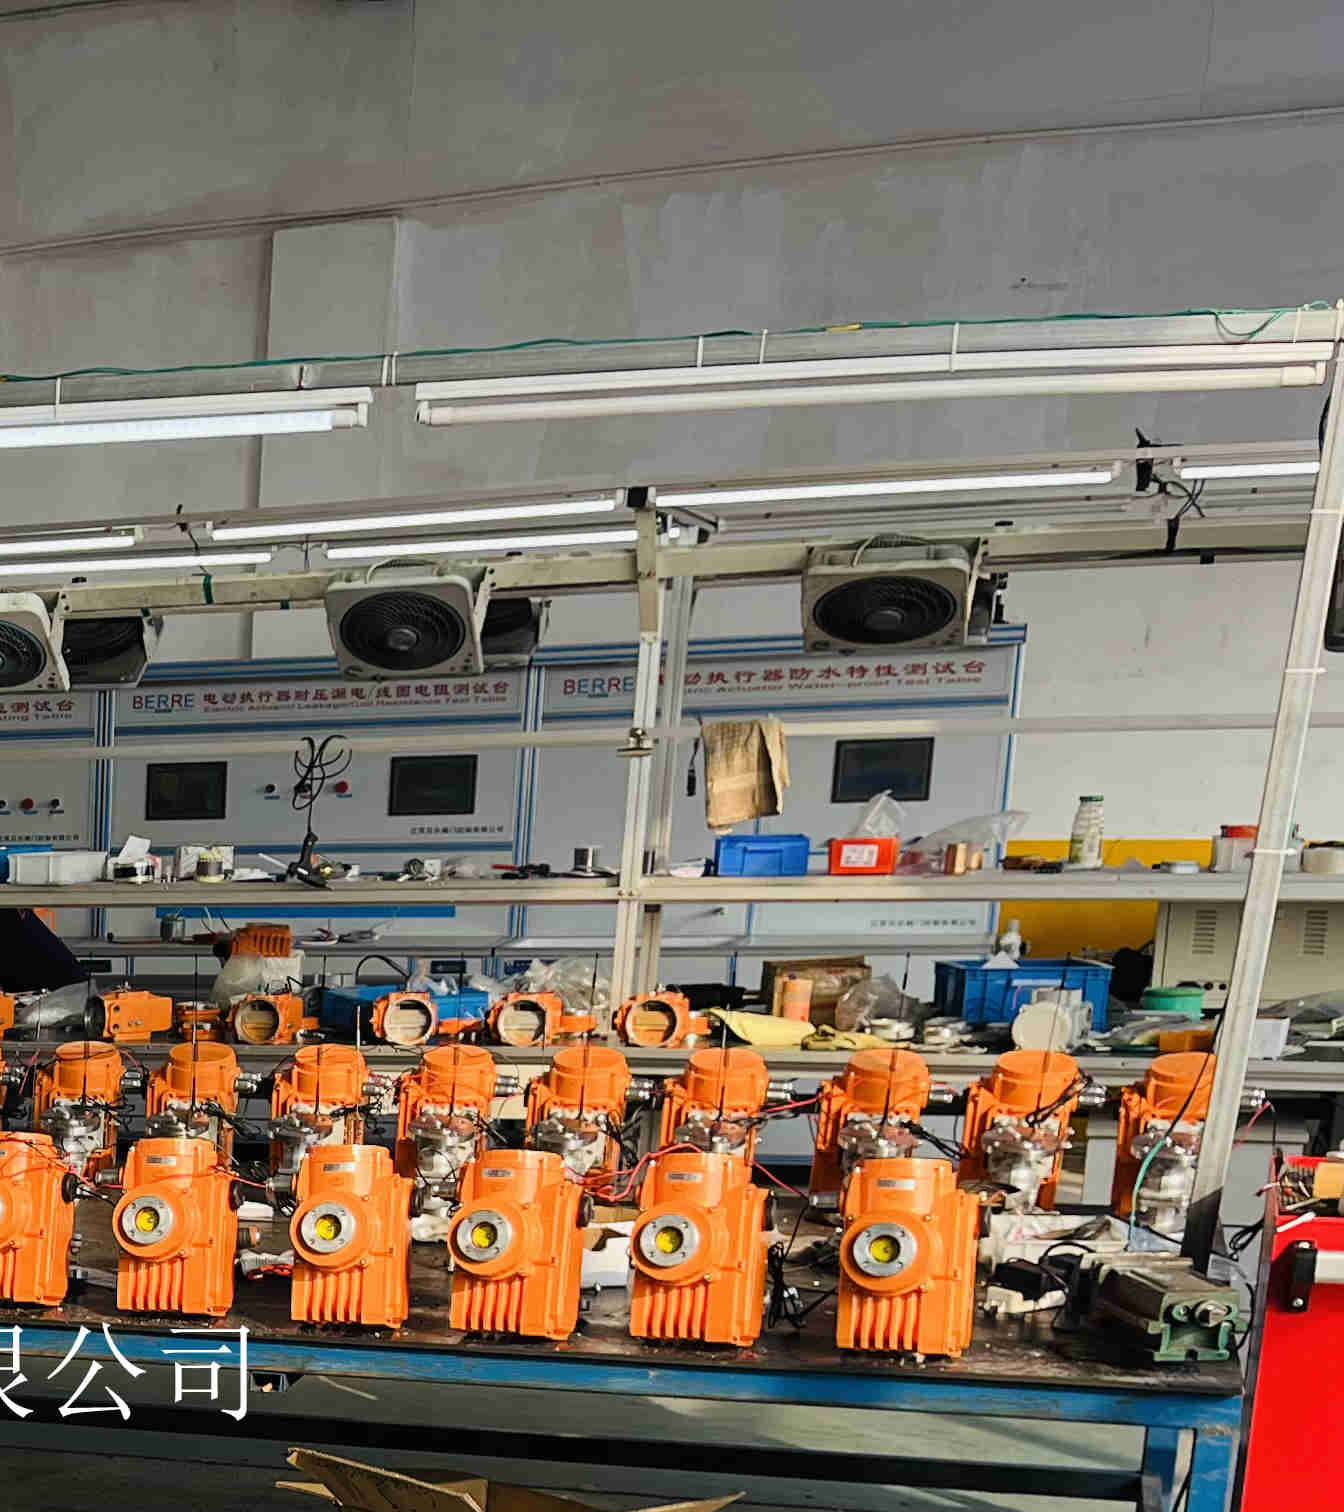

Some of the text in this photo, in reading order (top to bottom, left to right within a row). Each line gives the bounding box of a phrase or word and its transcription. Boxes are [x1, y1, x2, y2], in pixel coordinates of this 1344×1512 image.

[658, 660, 986, 686] 动执行器防水特性测试台
[563, 676, 635, 696] BERRE
[132, 693, 195, 710] BERRE
